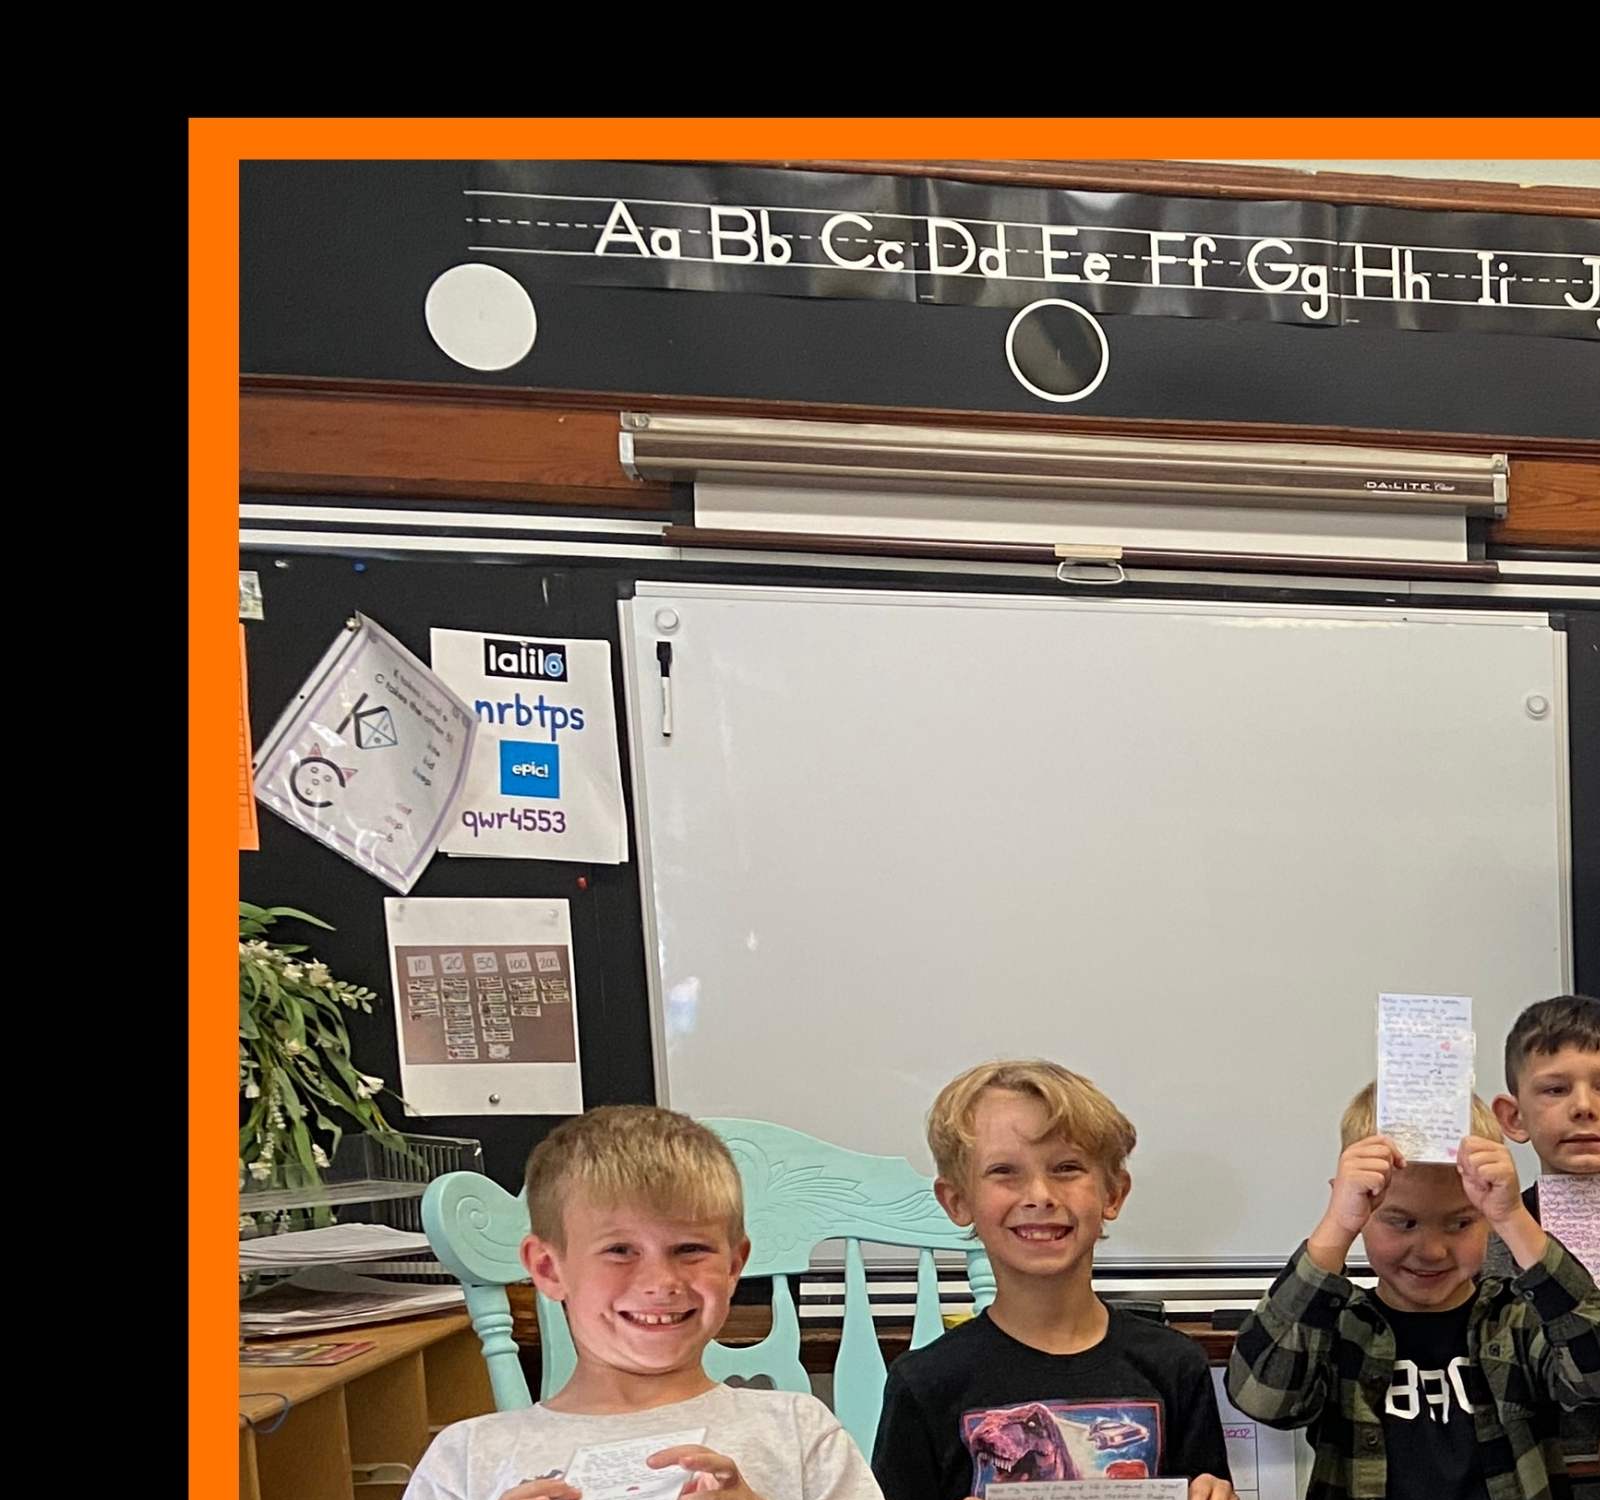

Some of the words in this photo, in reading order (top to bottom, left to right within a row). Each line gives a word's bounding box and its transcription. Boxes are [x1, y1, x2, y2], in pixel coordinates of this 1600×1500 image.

[595, 201, 680, 259] Aa
[710, 206, 792, 265] Bb
[821, 214, 905, 271] Cc
[927, 217, 1005, 279] Dd
[1041, 227, 1111, 284] Ee
[1151, 232, 1216, 289] Ff
[1247, 239, 1329, 319] Gg
[1355, 245, 1430, 301] Hh
[1476, 252, 1509, 305] Ii
[489, 642, 564, 677] lalilo
[475, 693, 585, 742] nrbtps
[462, 808, 566, 837] qwr4553
